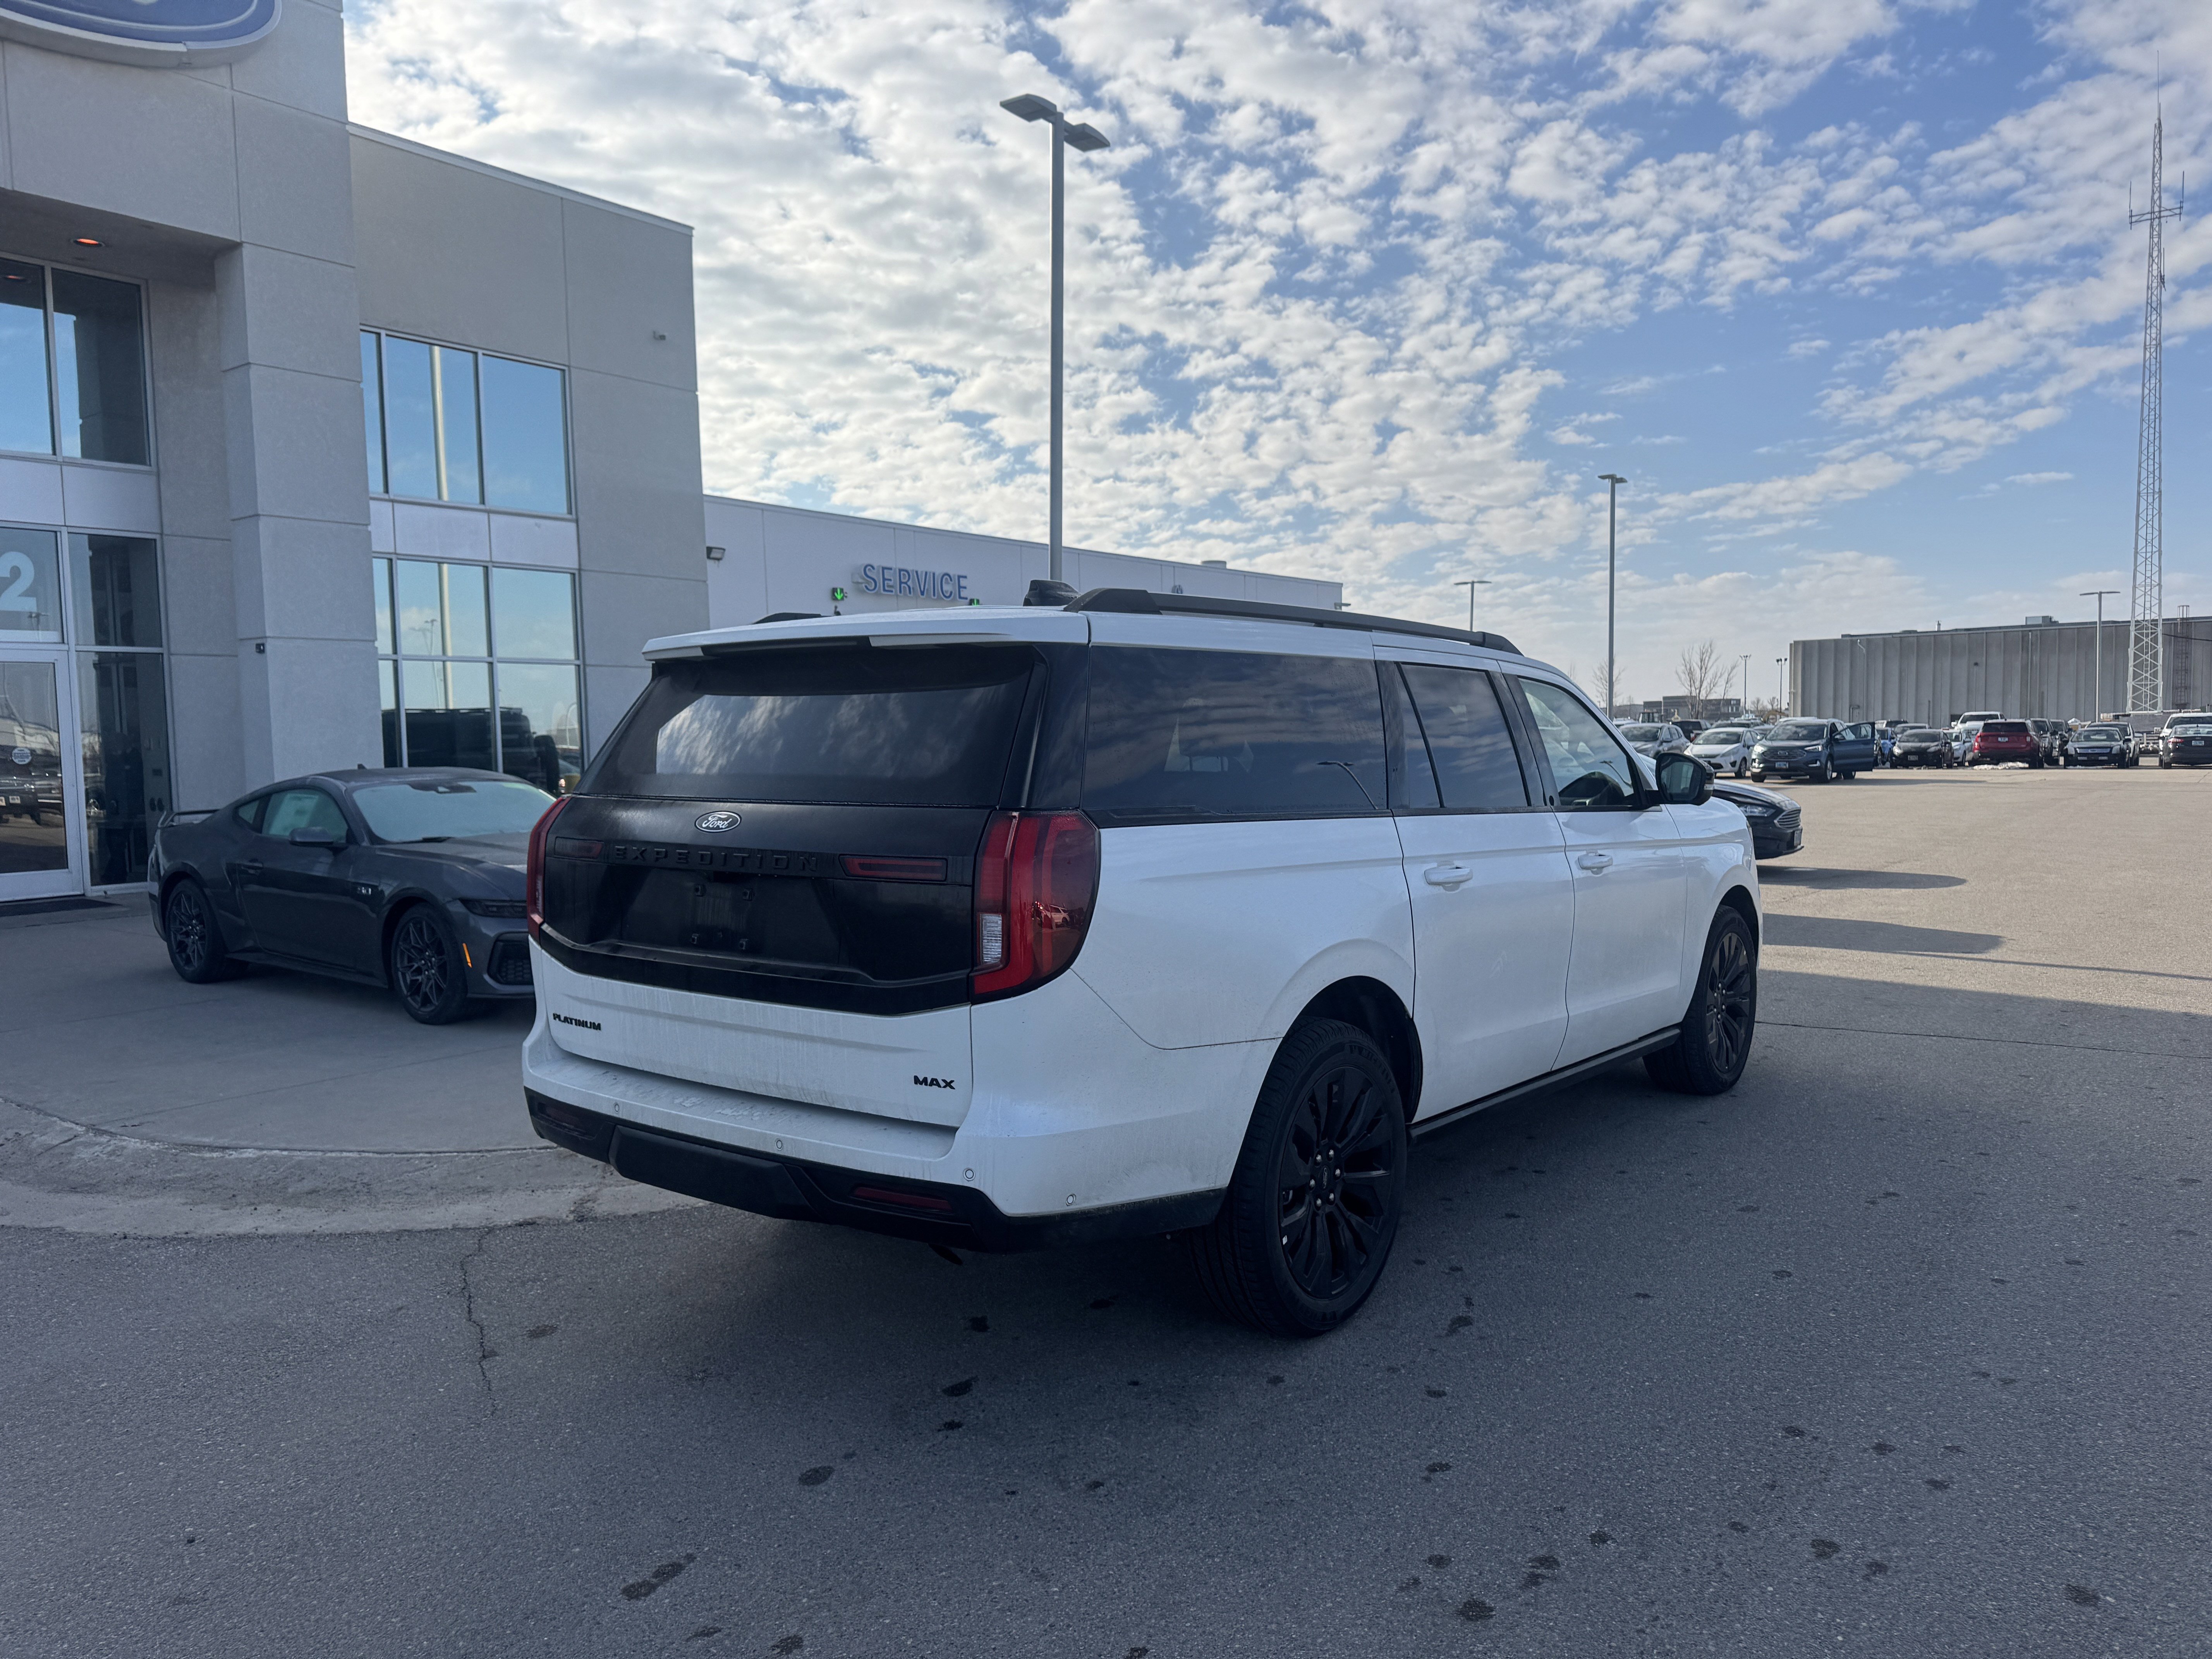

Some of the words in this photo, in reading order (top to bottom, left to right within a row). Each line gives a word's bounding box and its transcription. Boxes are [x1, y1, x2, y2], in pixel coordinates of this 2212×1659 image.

[863, 564, 968, 600] SERVICE
[702, 814, 732, 828] Ford
[615, 845, 818, 871] EXPEDITION
[553, 1013, 601, 1031] PLATINUM
[914, 1075, 955, 1090] MAX
